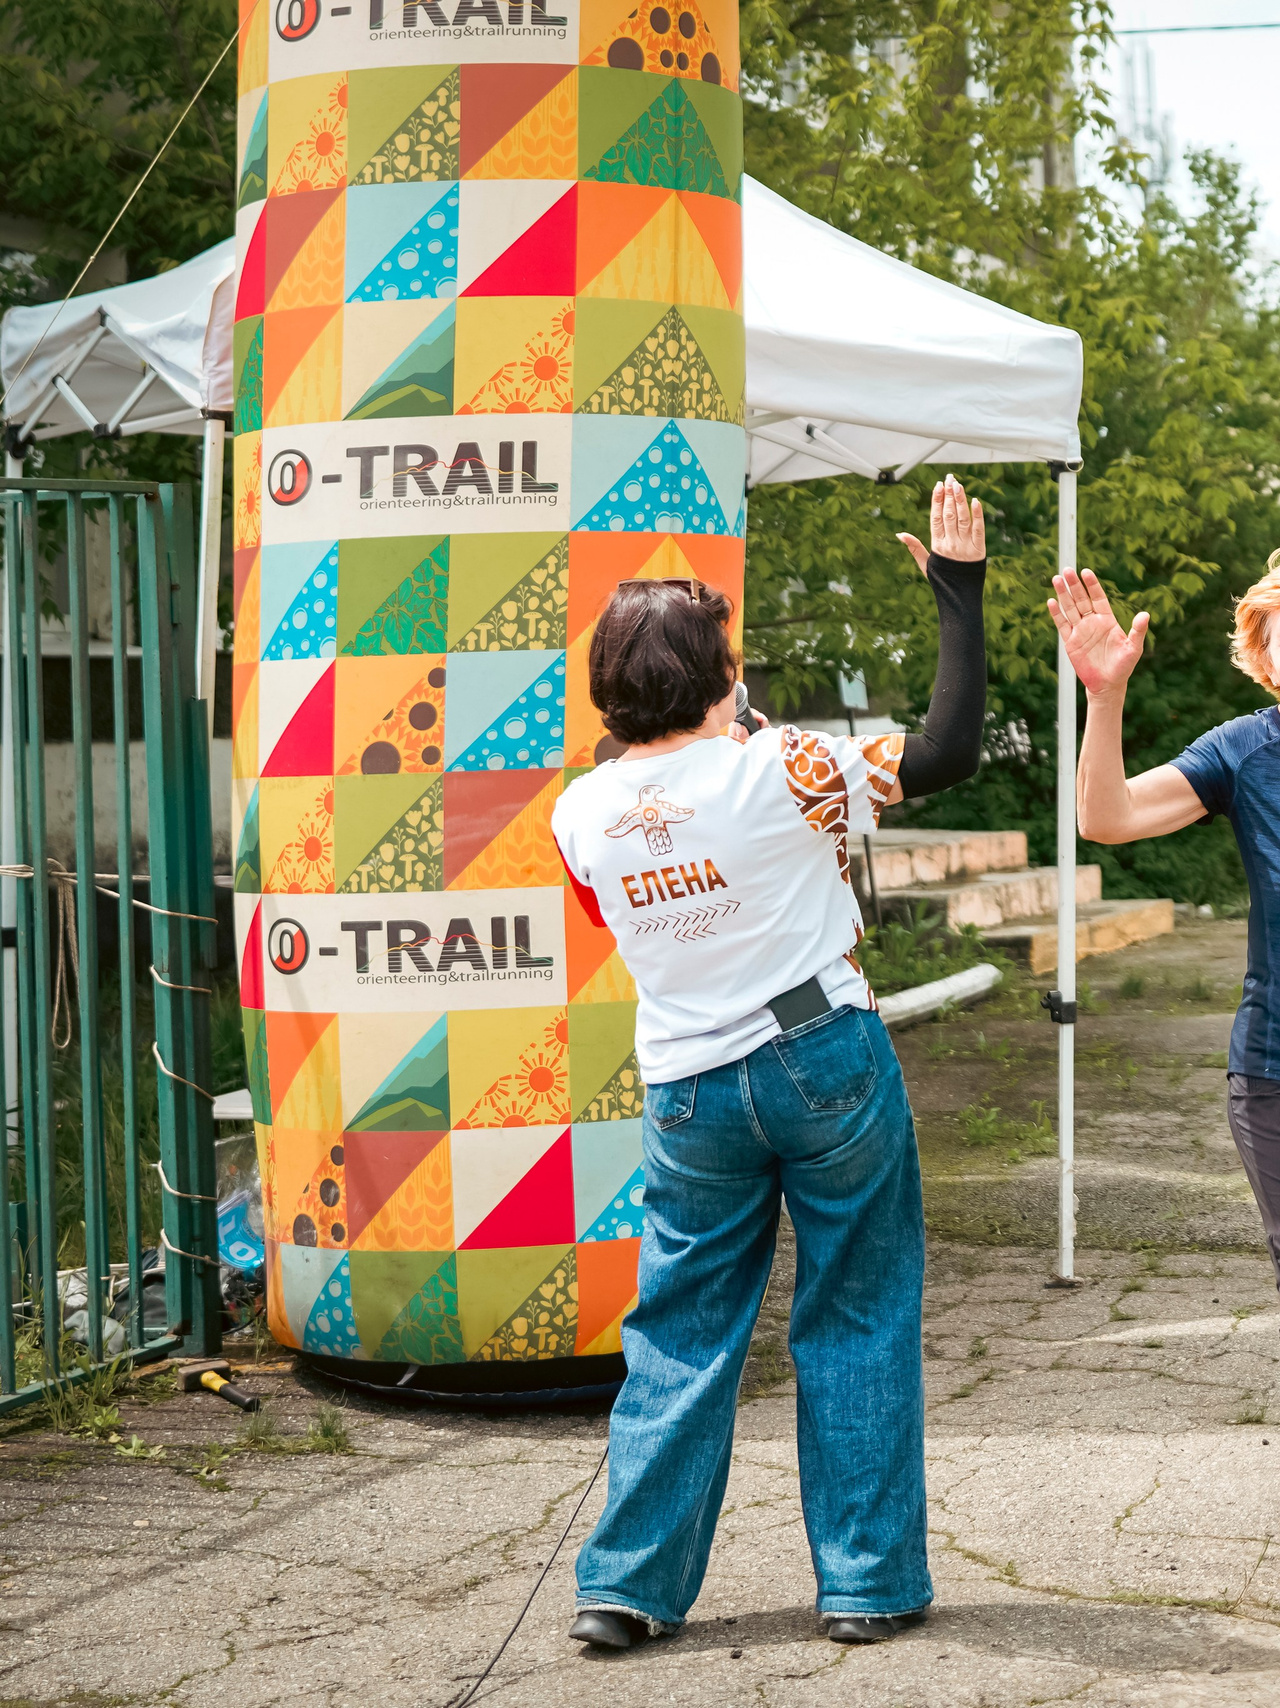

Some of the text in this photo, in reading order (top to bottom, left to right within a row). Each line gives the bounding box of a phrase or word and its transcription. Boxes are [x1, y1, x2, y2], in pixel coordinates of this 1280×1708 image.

[370, 25, 567, 41] orienteering&trailrunning
[360, 493, 558, 510] orienteering&trailrunning
[621, 858, 728, 908] ЕЛЕНА
[357, 968, 553, 986] orienteering&trailrunning
